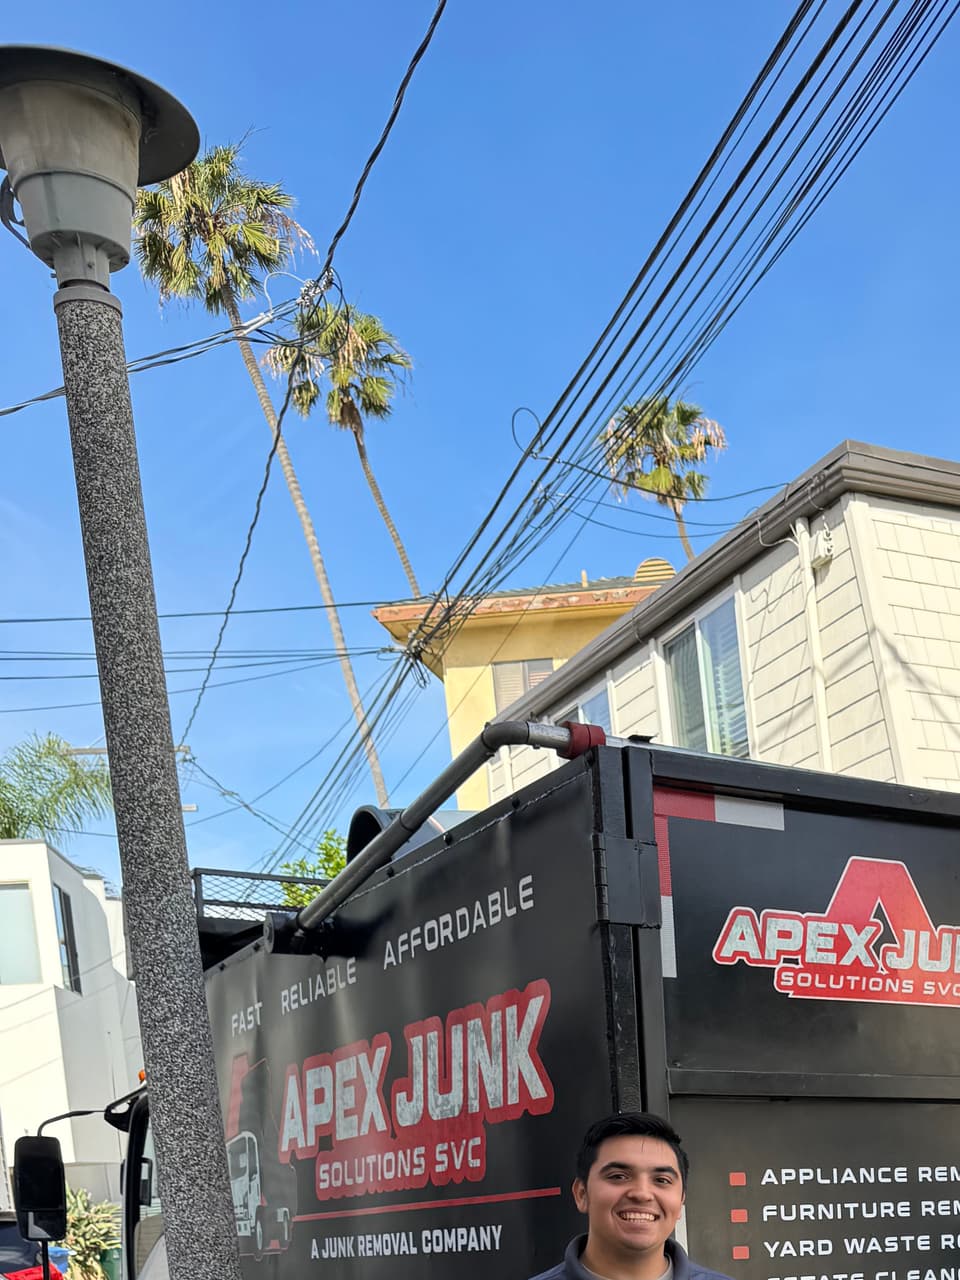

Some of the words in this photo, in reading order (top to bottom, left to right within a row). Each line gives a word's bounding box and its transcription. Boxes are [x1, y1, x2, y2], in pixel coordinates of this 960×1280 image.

[383, 874, 534, 970] AFFORDABLE
[719, 915, 878, 968] APEX
[281, 957, 357, 1016] RELIABLE
[779, 971, 914, 994] SOLUTIONS
[231, 1001, 263, 1038] FAST
[281, 1045, 388, 1152] APEX
[395, 994, 548, 1128] JUNK
[319, 1146, 426, 1189] SOLUTIONS
[434, 1136, 482, 1173] SVC
[760, 1166, 908, 1185] APPLIANCE
[762, 1201, 912, 1222] FURNITURE
[311, 1239, 319, 1259] A
[321, 1236, 355, 1259] JUNK
[357, 1231, 417, 1257] REMOVAL
[421, 1225, 502, 1253] COMPANY
[763, 1239, 834, 1258] YARD
[843, 1235, 931, 1254] WASTE
